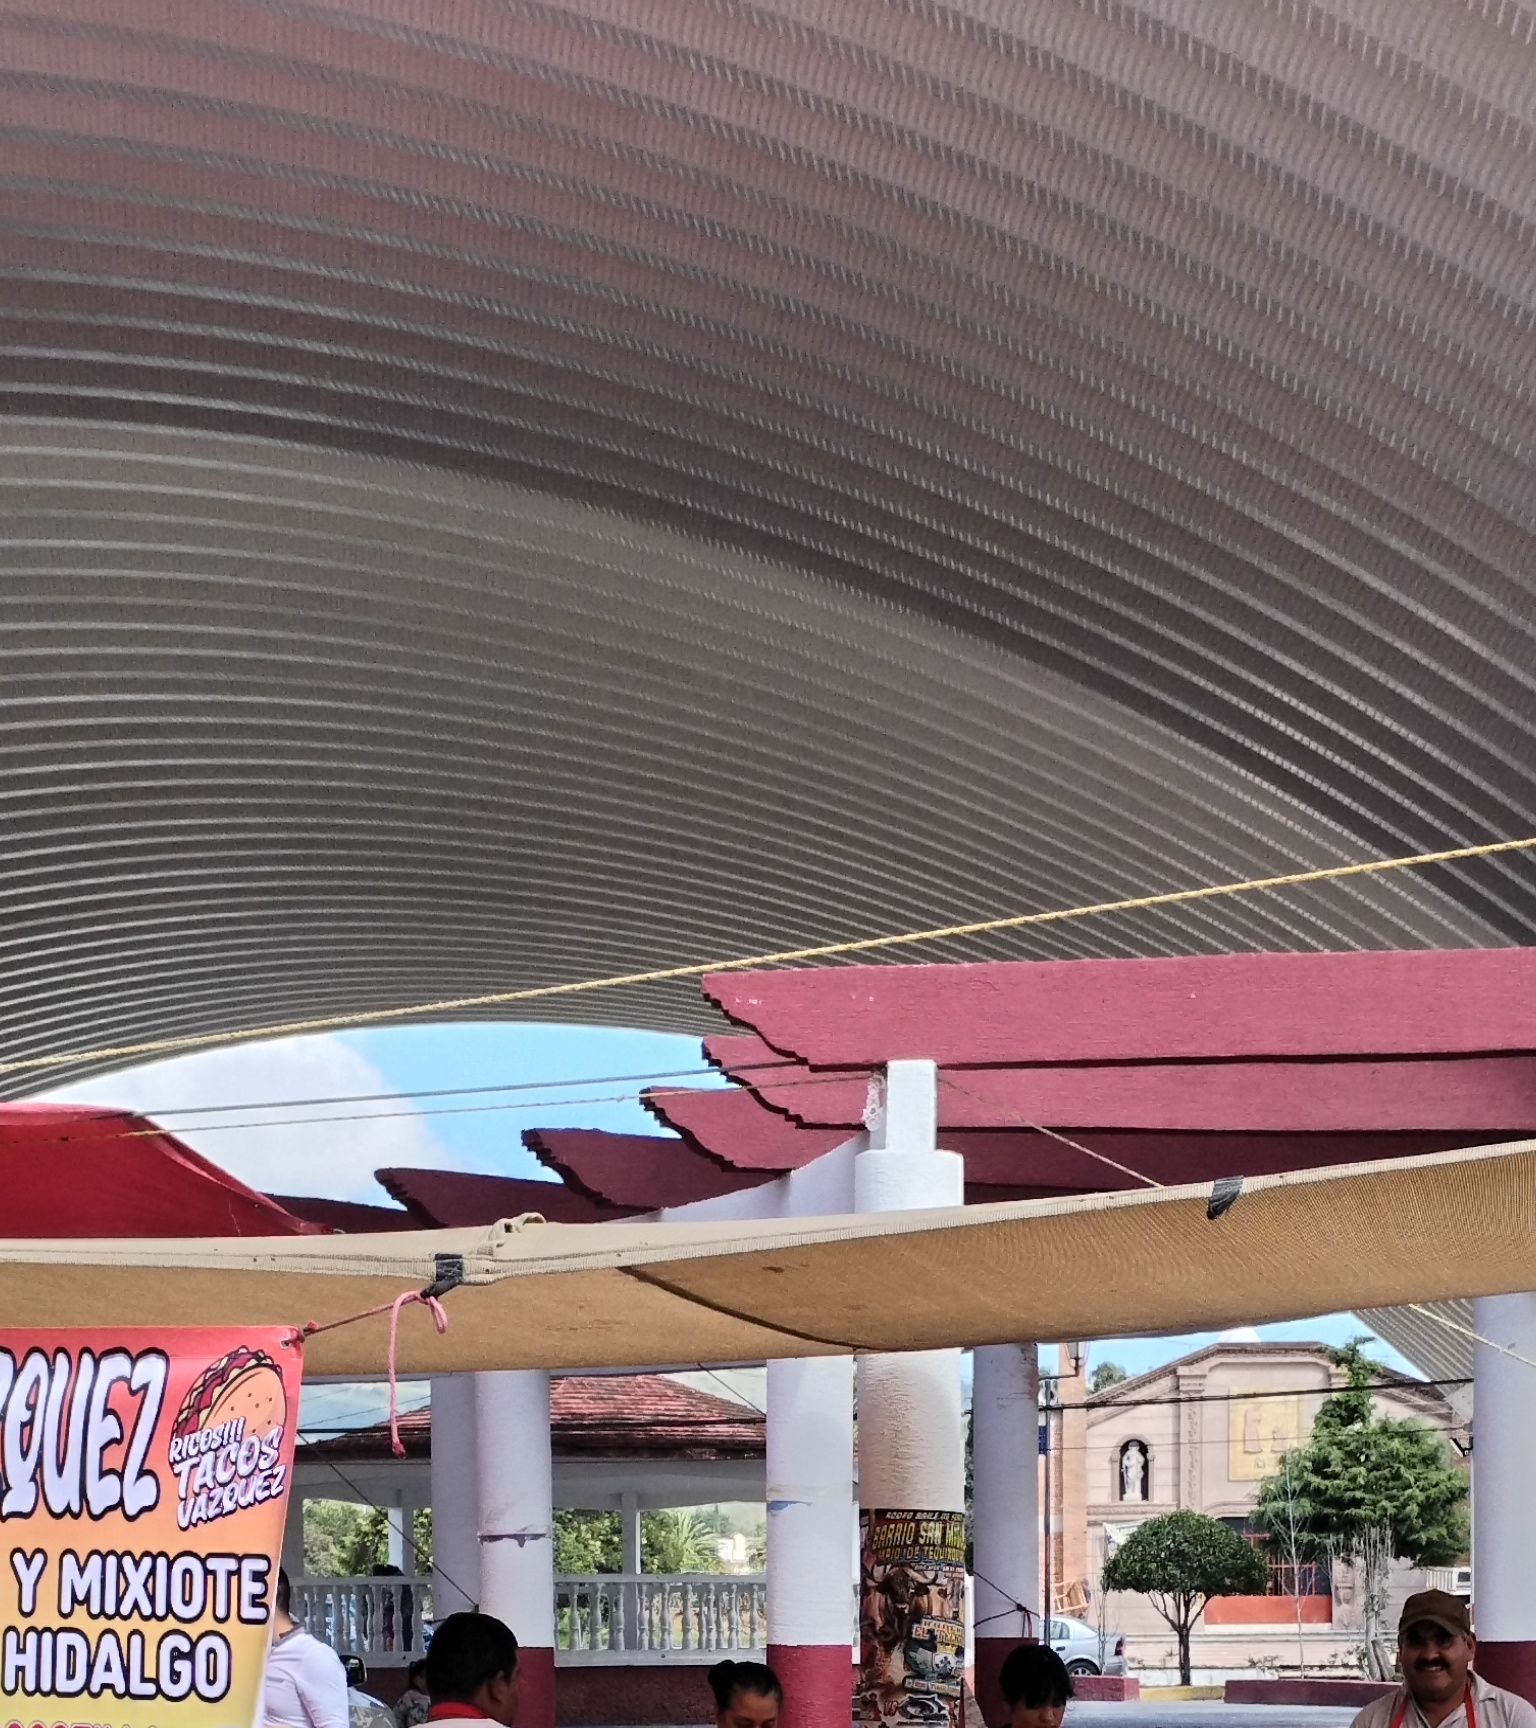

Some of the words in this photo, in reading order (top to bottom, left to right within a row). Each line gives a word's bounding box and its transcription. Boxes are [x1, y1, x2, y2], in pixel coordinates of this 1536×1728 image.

[169, 1416, 246, 1465] RICOS!!!
[173, 1424, 284, 1499] TACOS
[177, 1464, 287, 1531] VAZQUEZ
[872, 1521, 915, 1550] BARRIO
[918, 1520, 944, 1545] SAN
[10, 1546, 48, 1618] Y
[59, 1549, 270, 1625] MIXIOTE
[1, 1626, 231, 1703] HIDALGO
